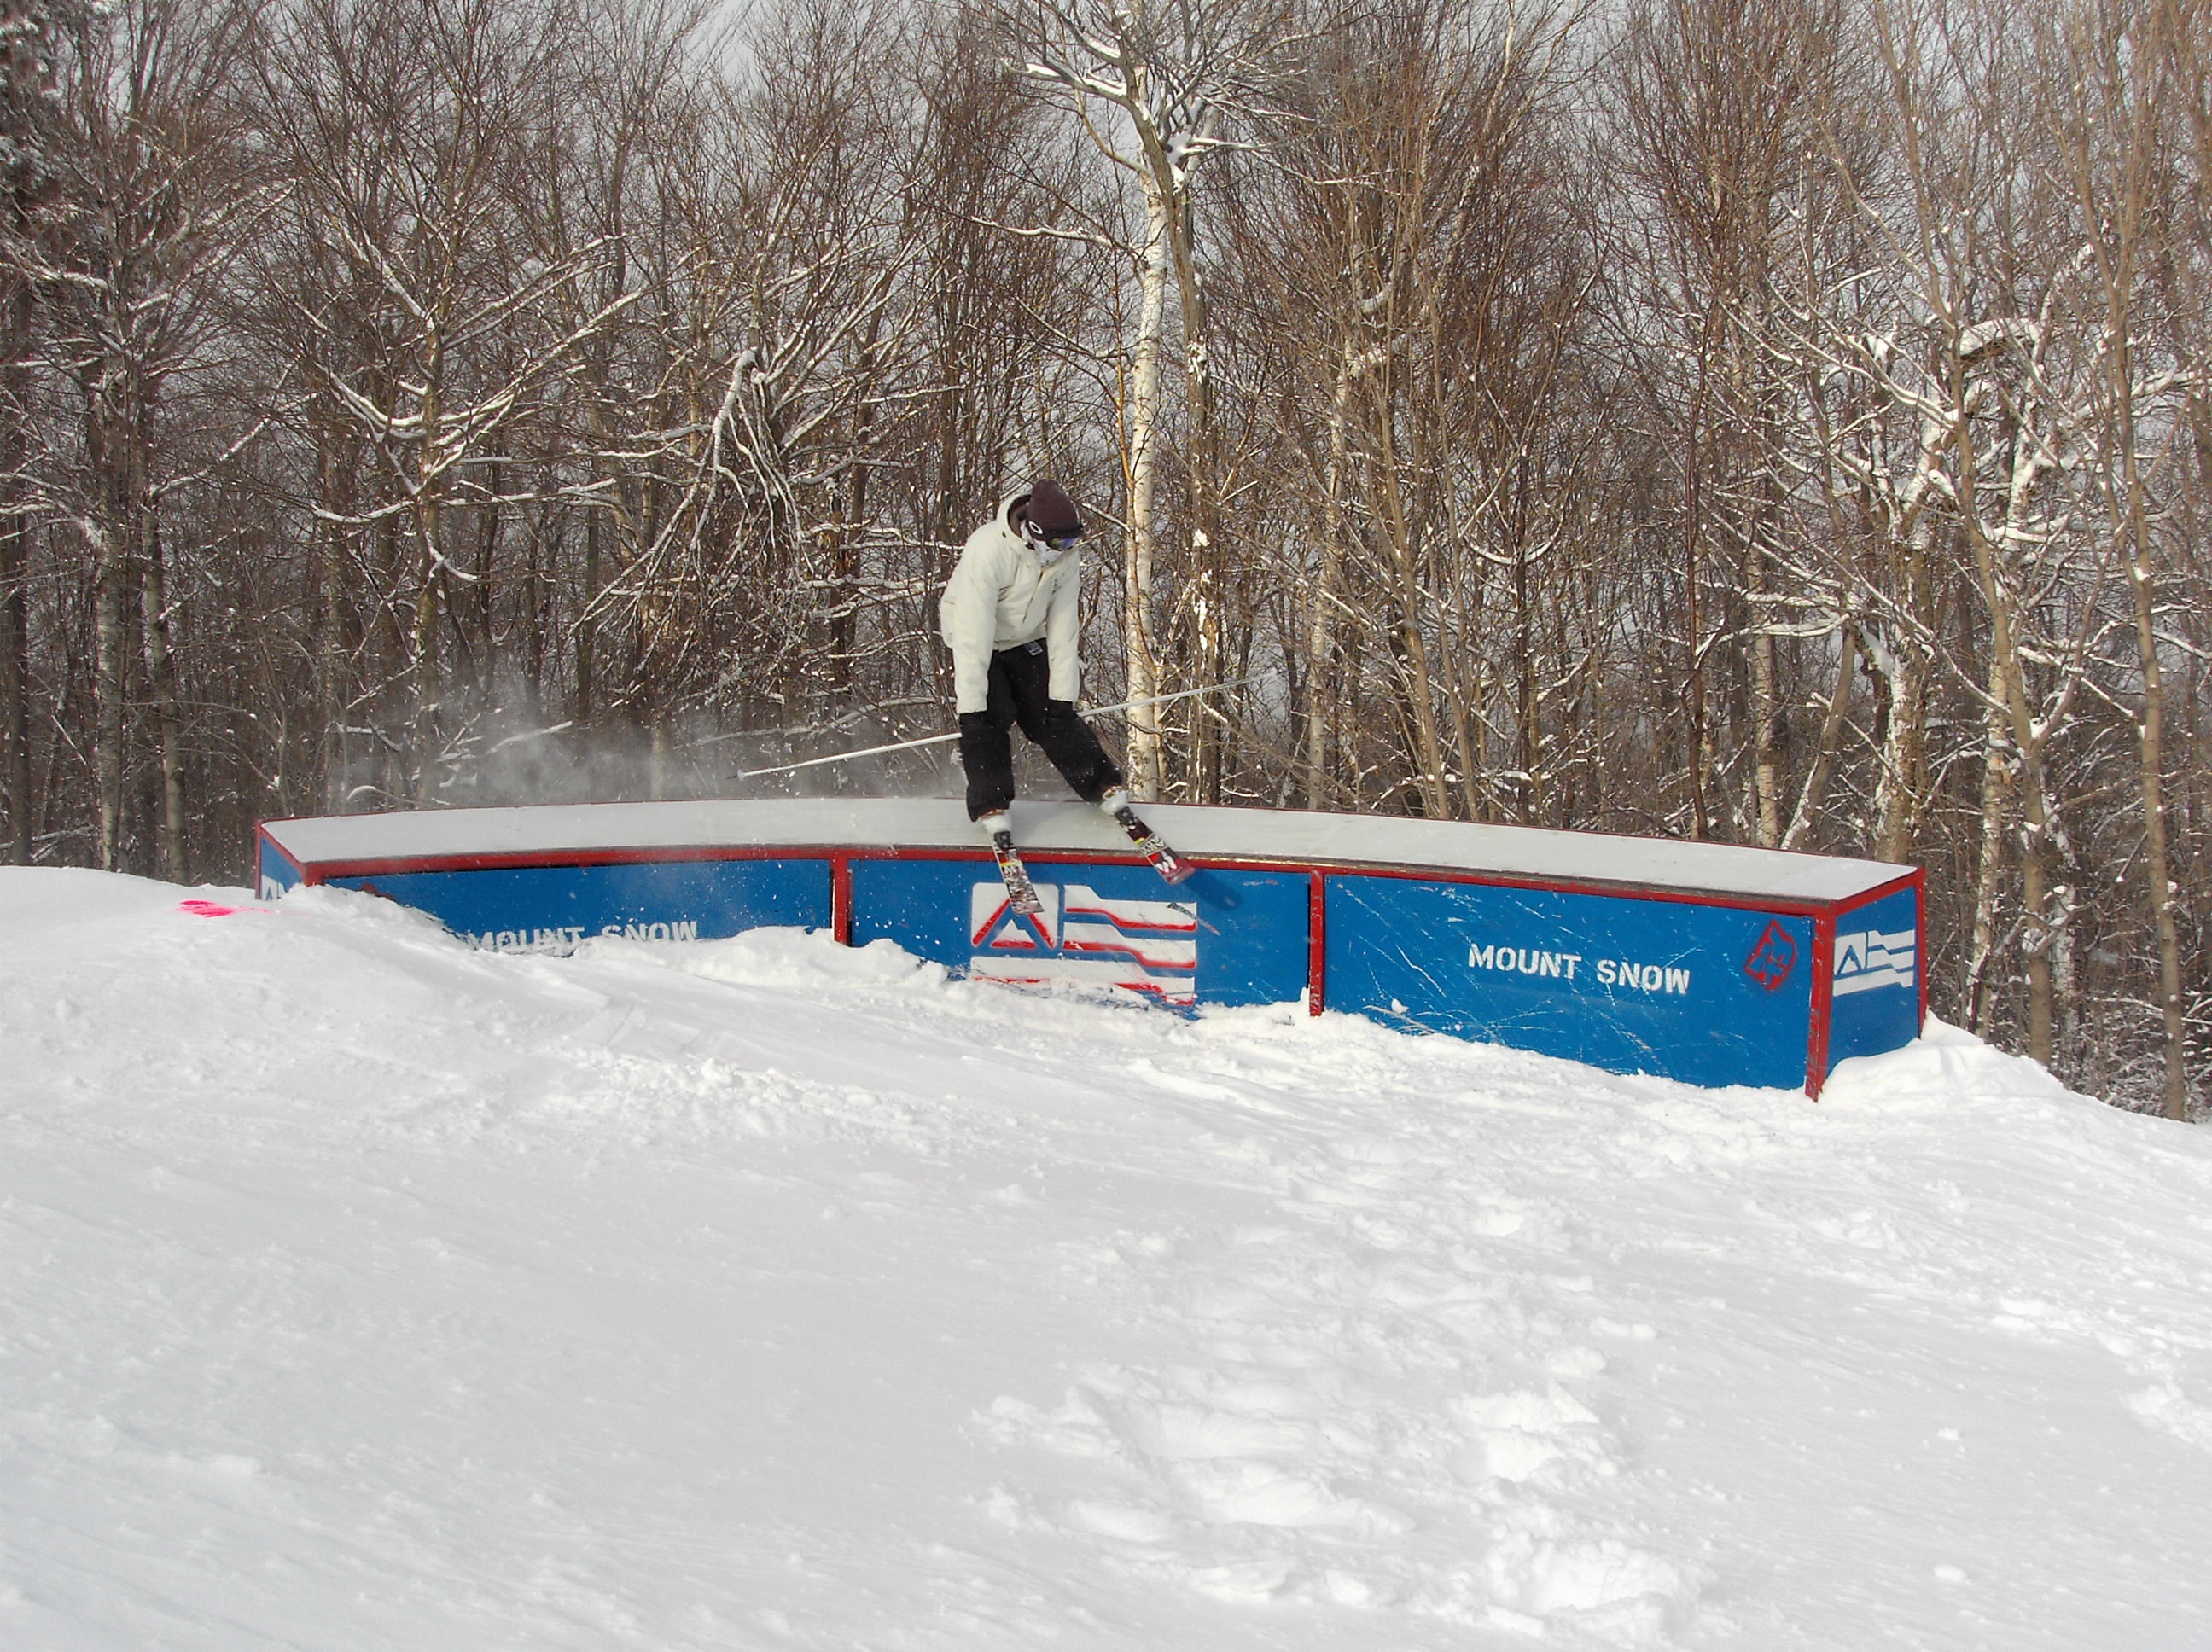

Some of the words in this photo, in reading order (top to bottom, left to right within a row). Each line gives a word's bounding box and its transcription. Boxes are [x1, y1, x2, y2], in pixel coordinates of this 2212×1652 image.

[466, 926, 585, 953] MOUNT
[601, 921, 697, 942] SNOW
[1468, 943, 1582, 980] MOUNT
[1597, 959, 1691, 995] SNOW
